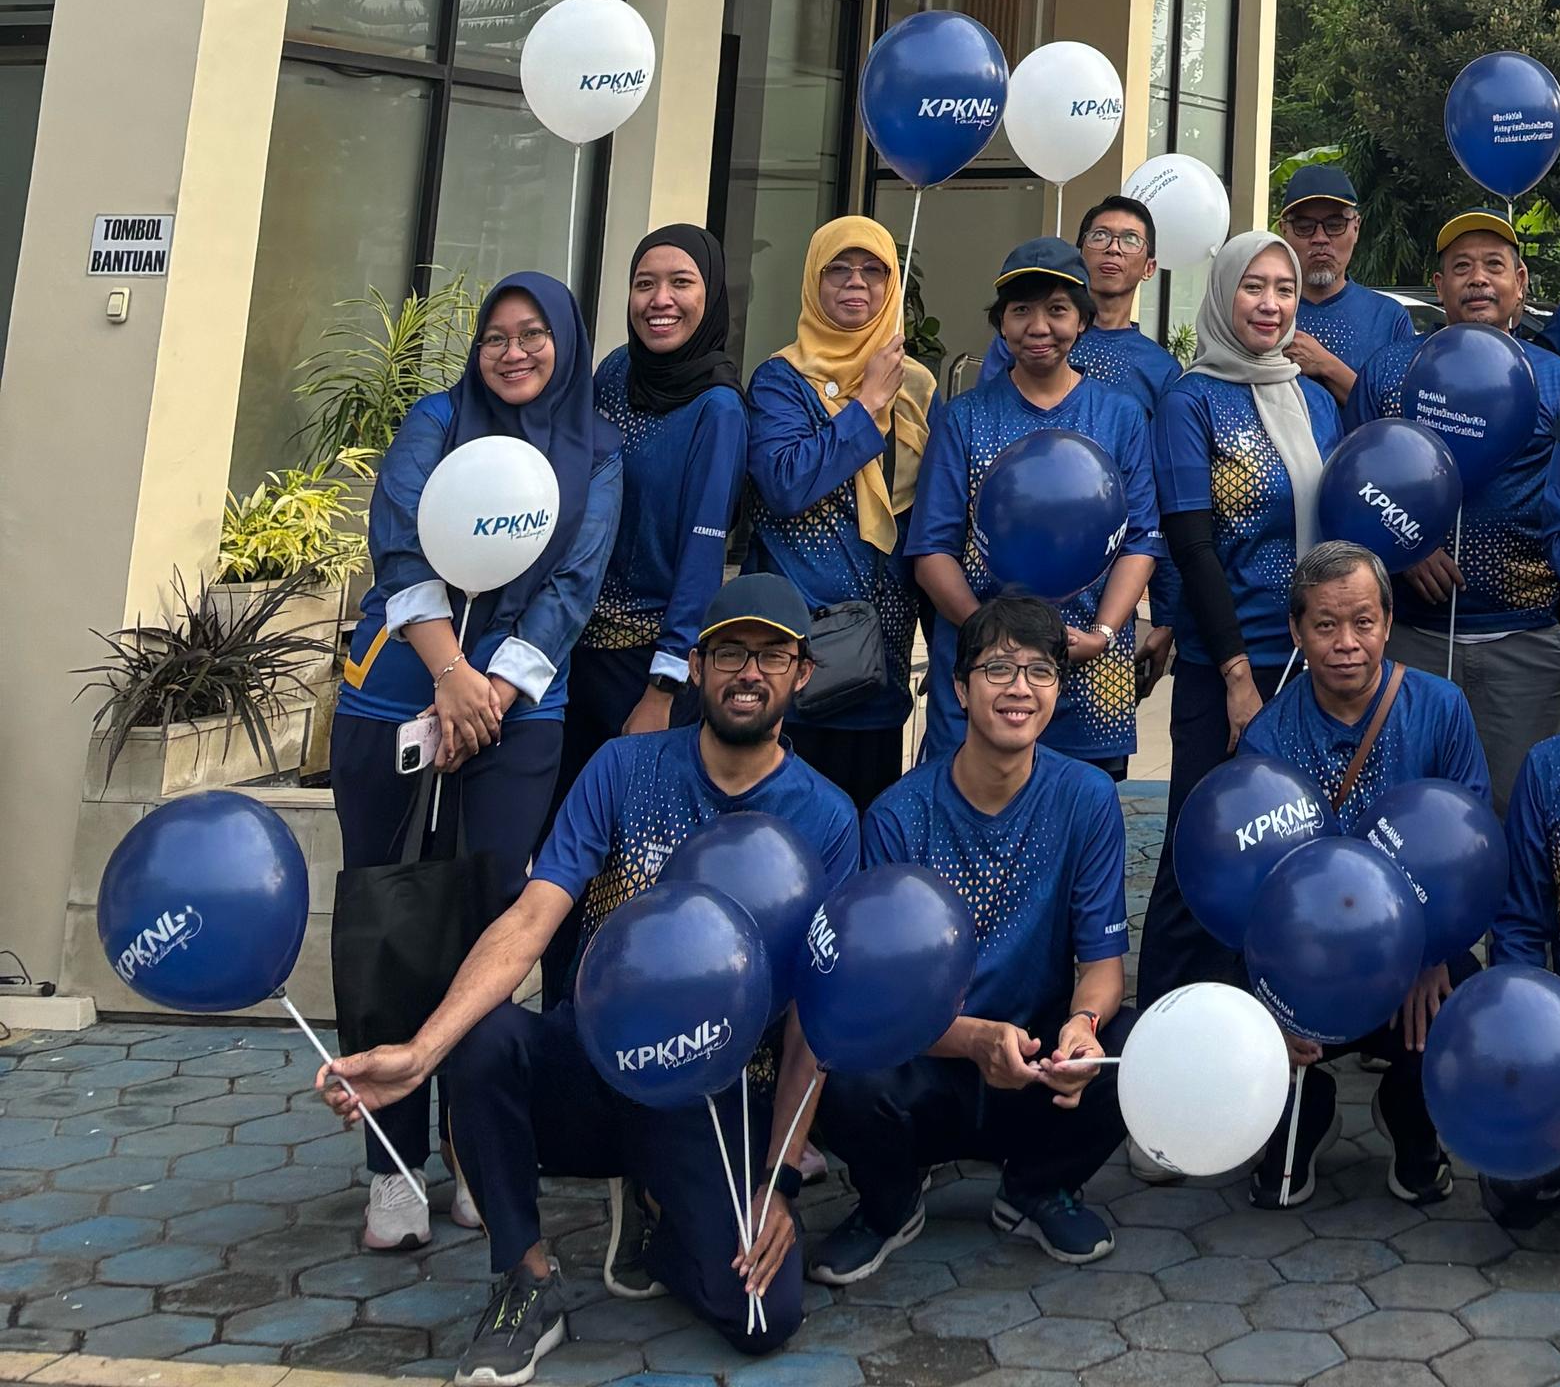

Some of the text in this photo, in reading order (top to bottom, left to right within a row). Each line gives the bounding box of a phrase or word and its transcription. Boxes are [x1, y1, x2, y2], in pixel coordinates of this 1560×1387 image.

[579, 69, 644, 90] KPKNL
[918, 98, 992, 117] KPKNL
[103, 219, 163, 240] TOMBOL
[91, 250, 166, 272] BANTUAN
[473, 509, 547, 536] KPKNL
[1359, 481, 1420, 540] KPKNL
[1235, 797, 1317, 851] KPKNL
[115, 911, 187, 984] KPKNL
[616, 1020, 720, 1071] KPKNL
